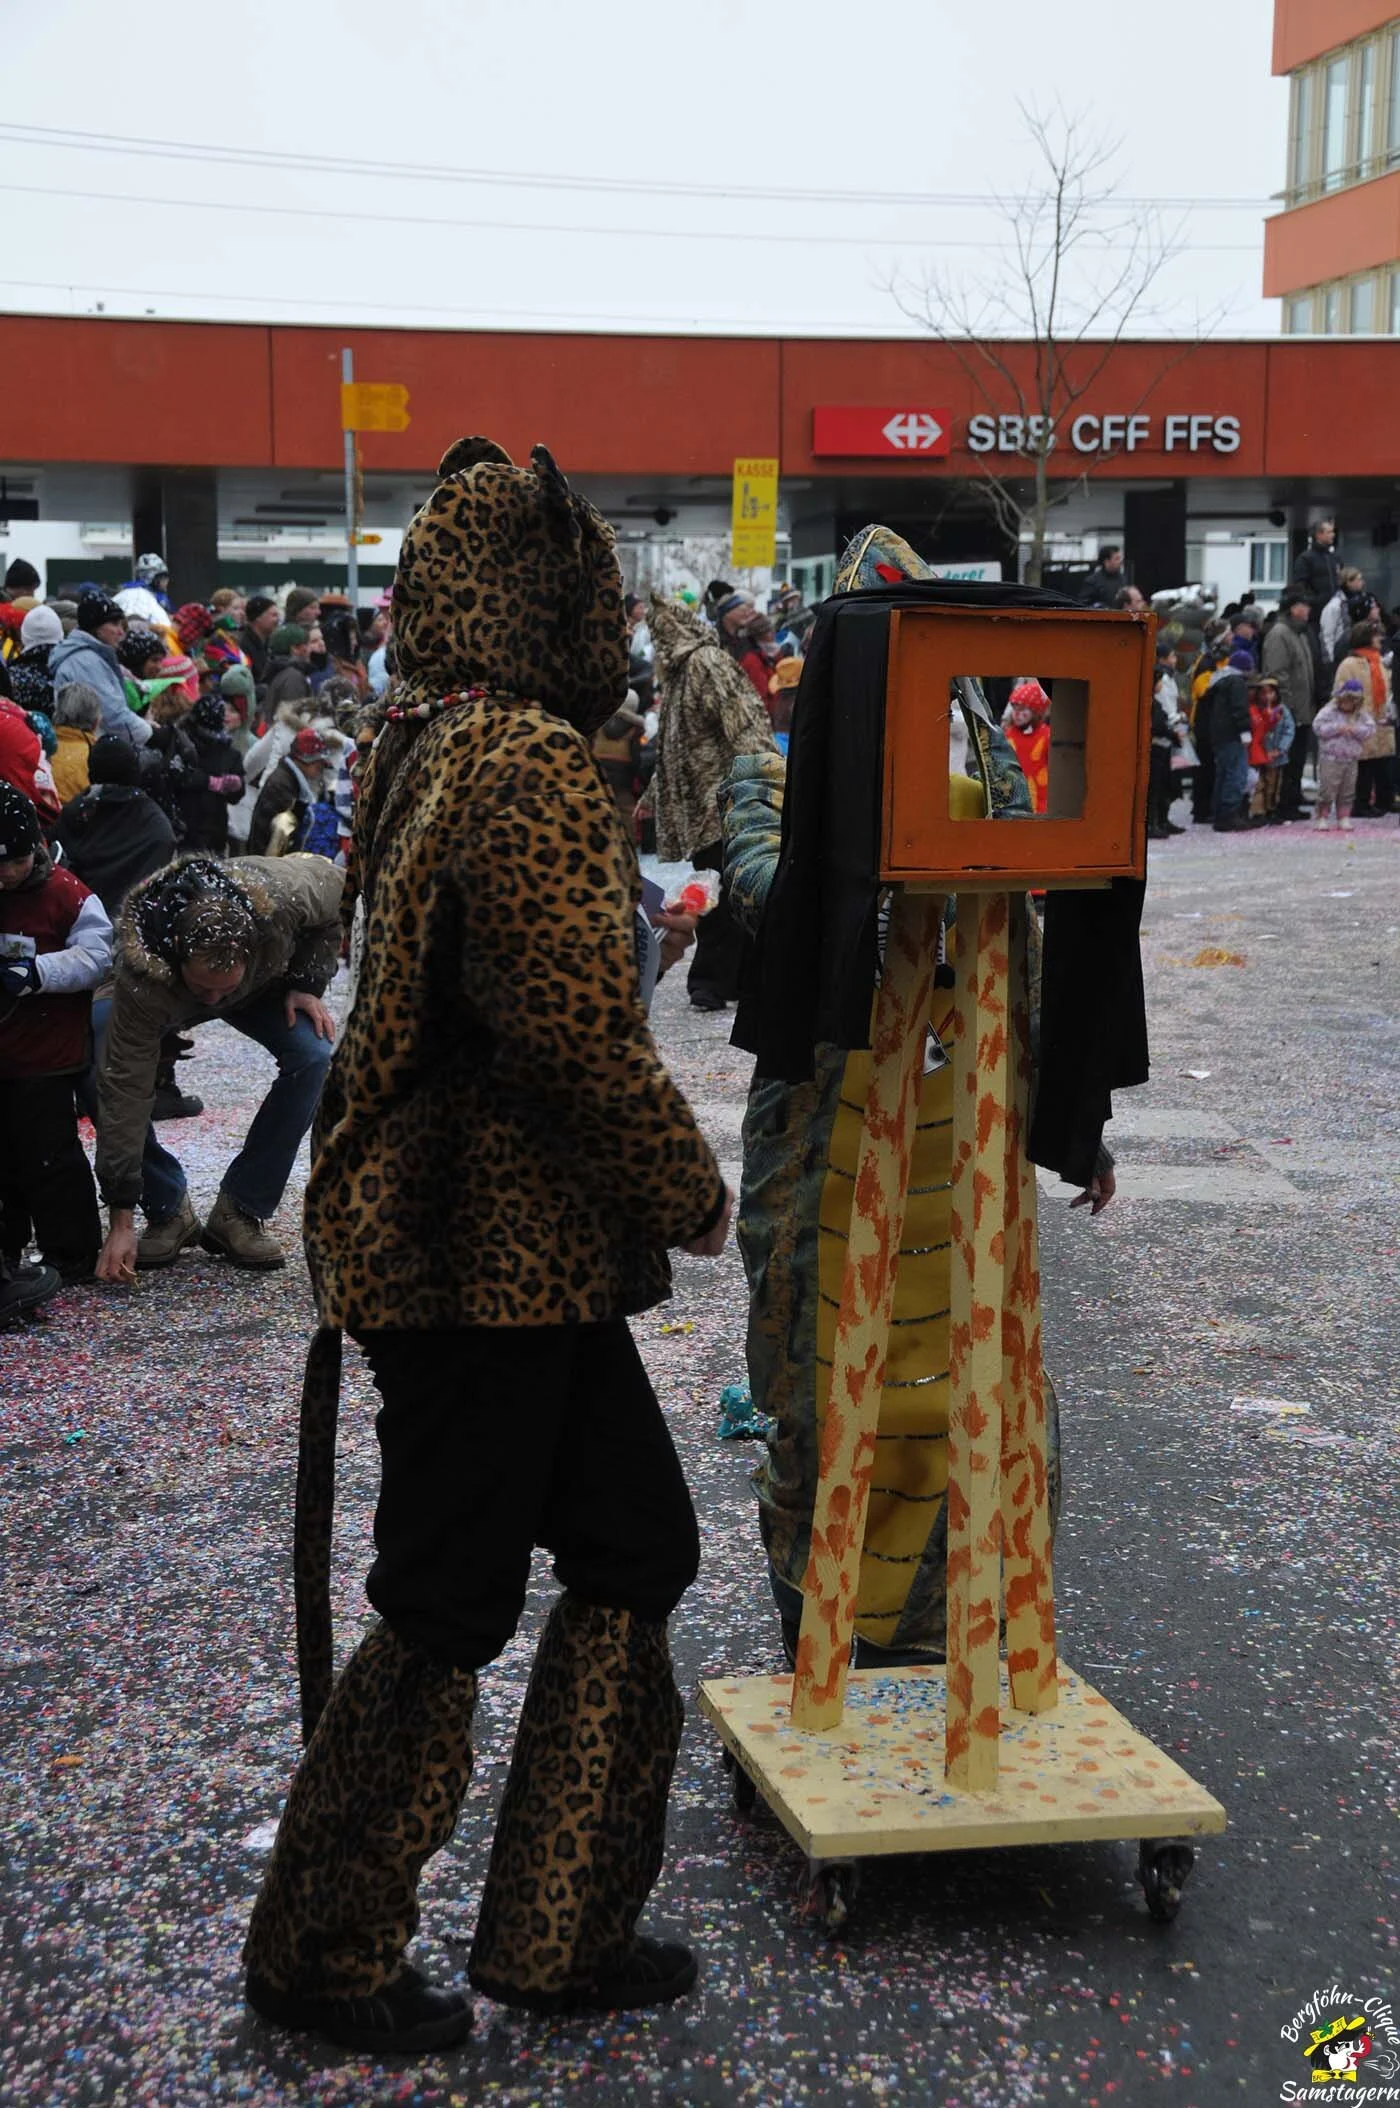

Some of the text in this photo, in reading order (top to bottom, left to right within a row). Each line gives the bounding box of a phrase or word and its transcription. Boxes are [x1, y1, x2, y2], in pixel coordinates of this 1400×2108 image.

[968, 414, 1241, 452] SBB CFF FFS
[736, 463, 775, 478] KASSE
